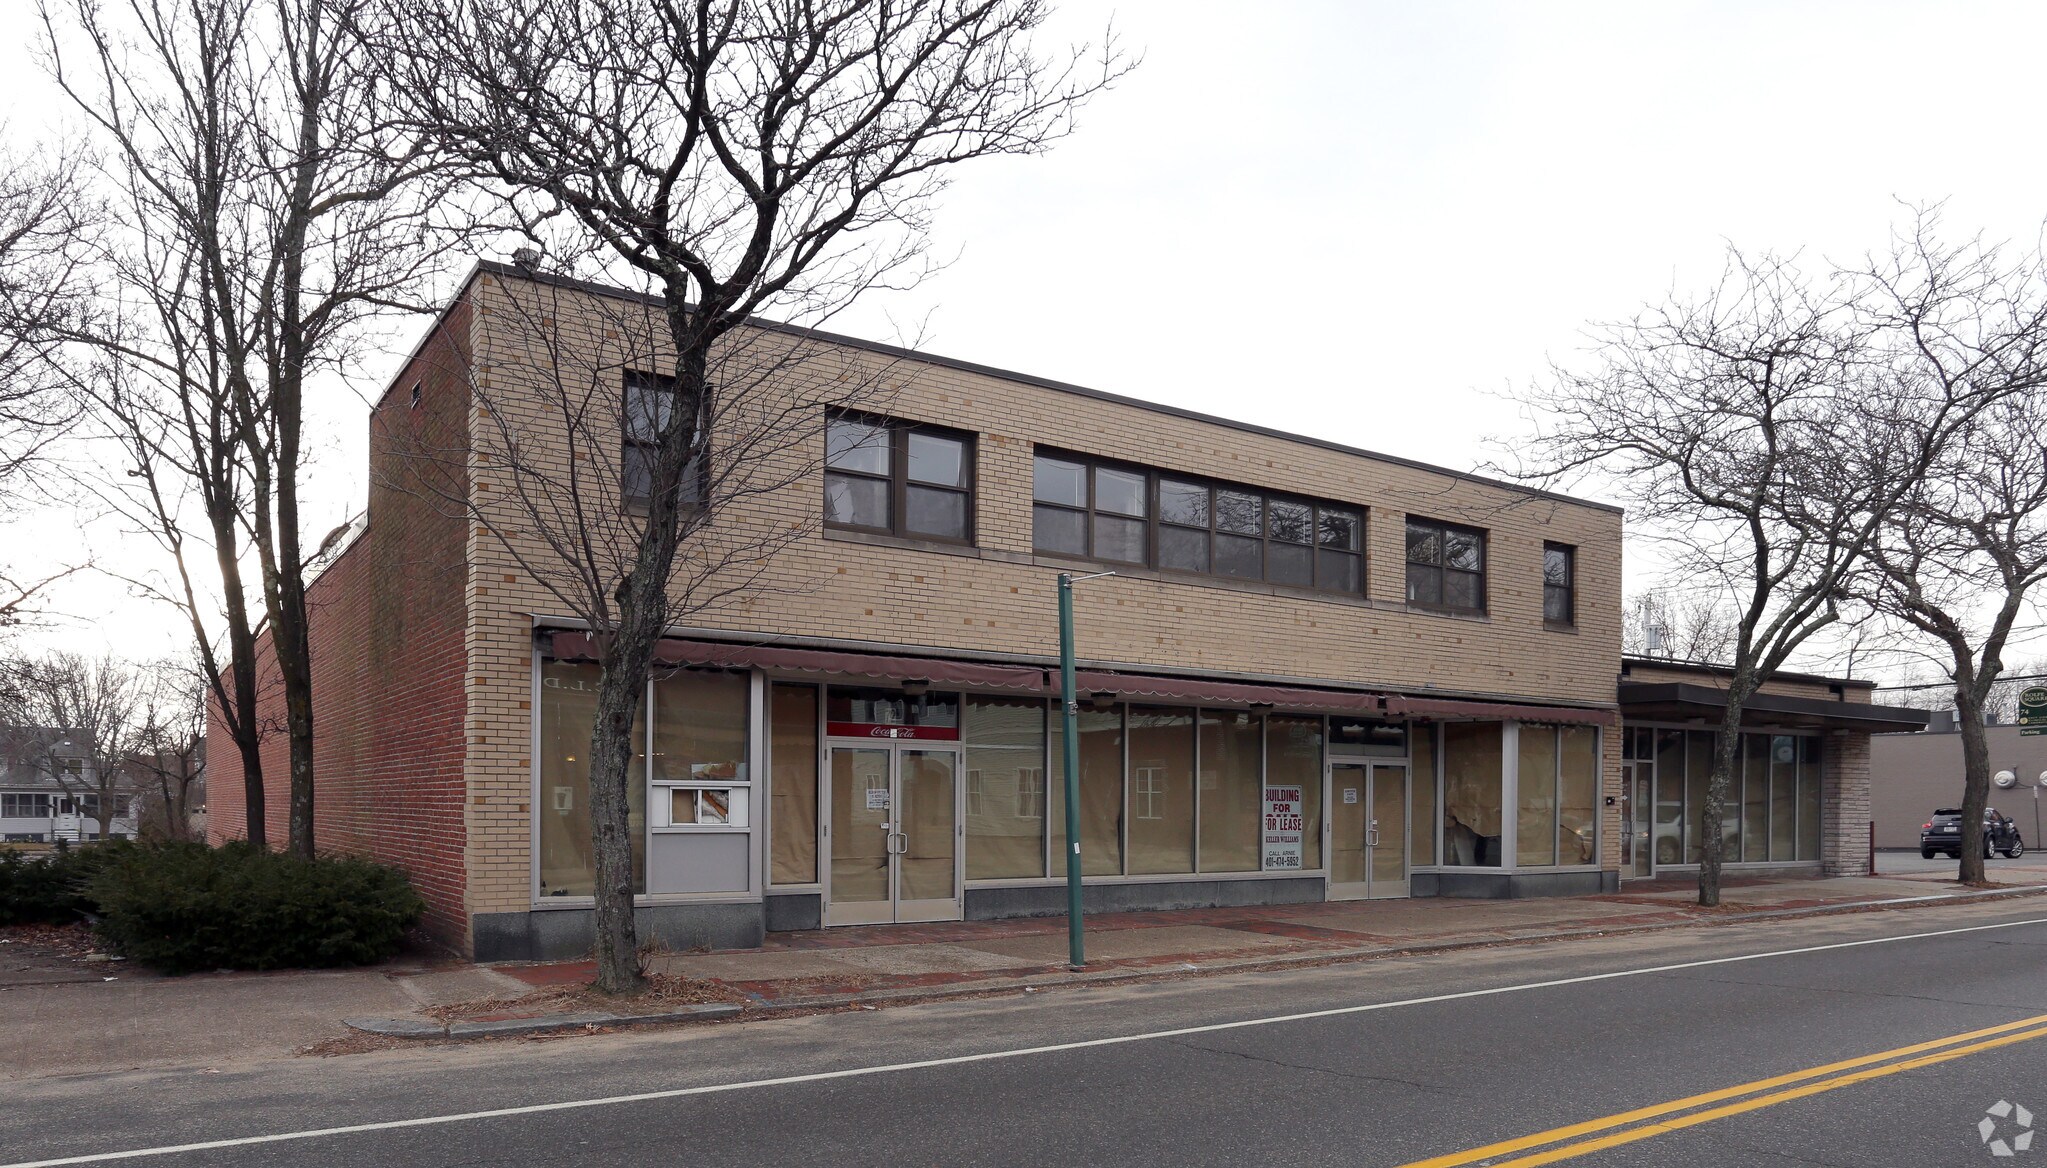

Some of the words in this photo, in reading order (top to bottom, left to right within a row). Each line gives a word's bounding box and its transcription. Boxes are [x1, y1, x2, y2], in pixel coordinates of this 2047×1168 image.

[870, 726, 916, 738] Cocaola
[1266, 790, 1299, 802] BUILDING
[1273, 804, 1290, 812] FOR
[1280, 818, 1302, 830] LEASE
